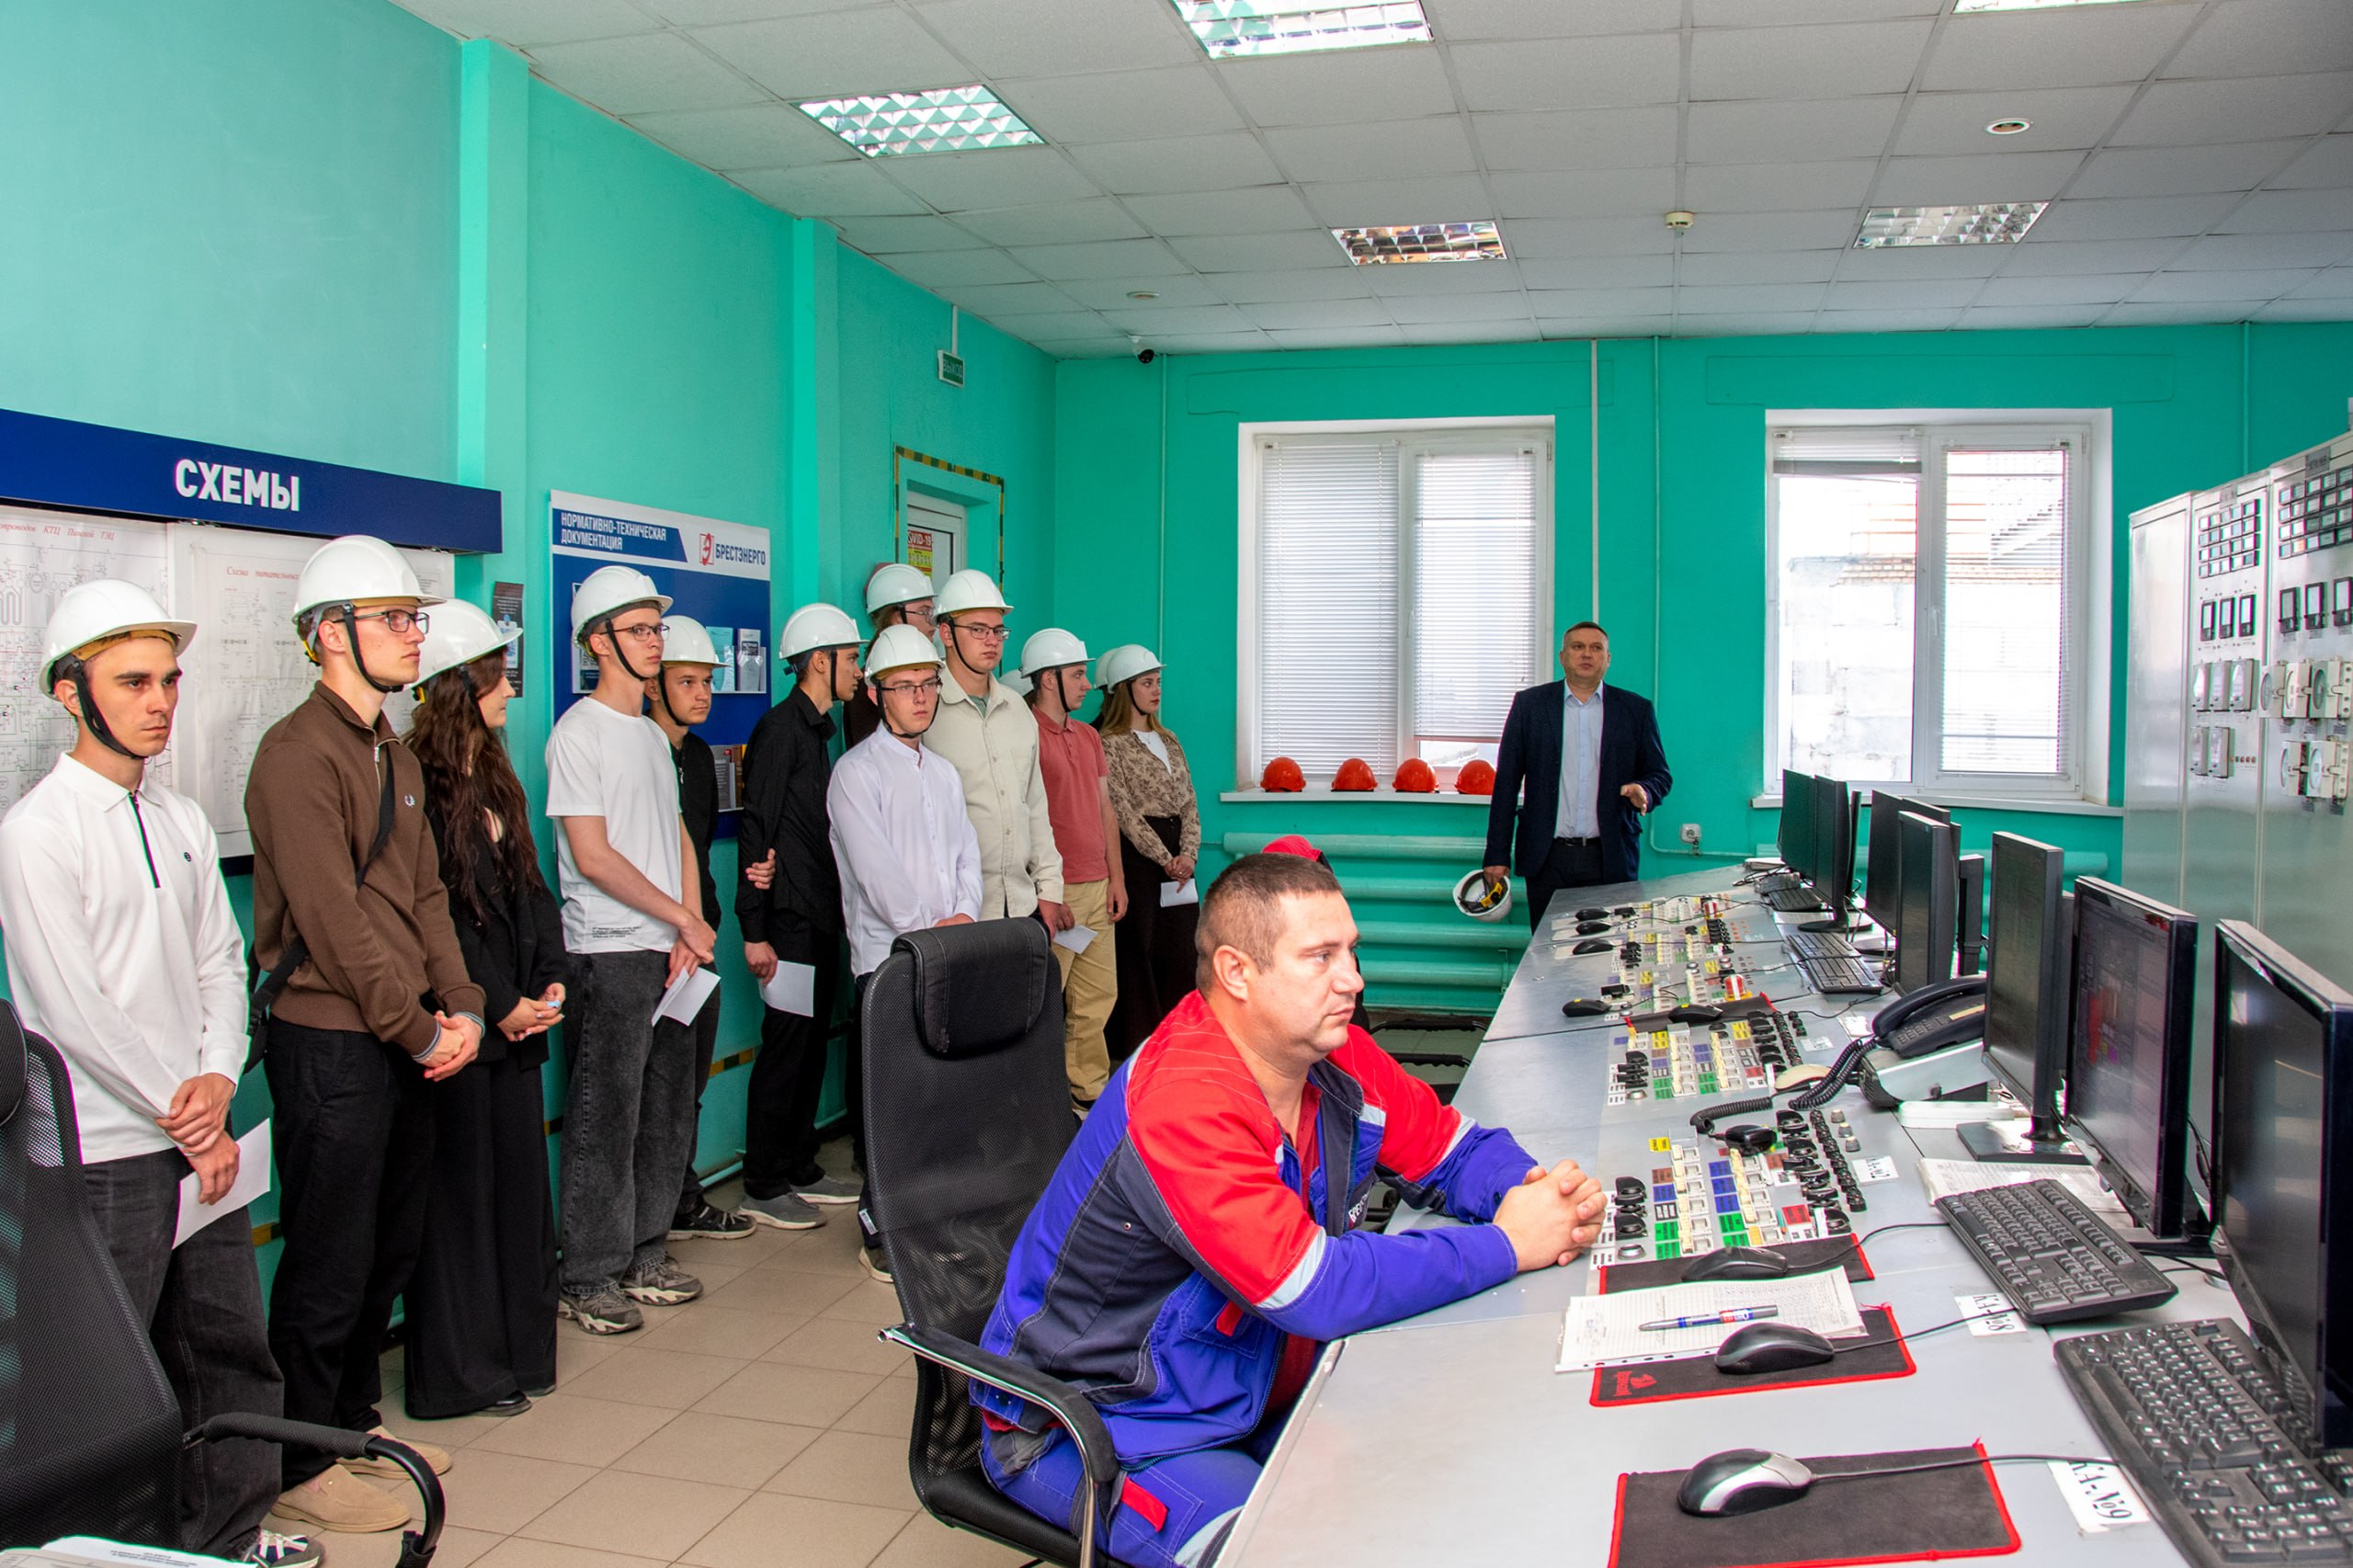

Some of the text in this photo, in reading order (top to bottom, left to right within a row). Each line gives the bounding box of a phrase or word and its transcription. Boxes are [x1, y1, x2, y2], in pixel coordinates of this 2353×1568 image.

[175, 459, 301, 512] СХЕМЫ
[561, 512, 667, 541] НОРМАТИВНО-ТЕХНИЧЕСКАЯ
[561, 528, 623, 551] ДОКУМЕНТАЦИЯ
[715, 543, 767, 566] БРЕСТЭНЕРГО
